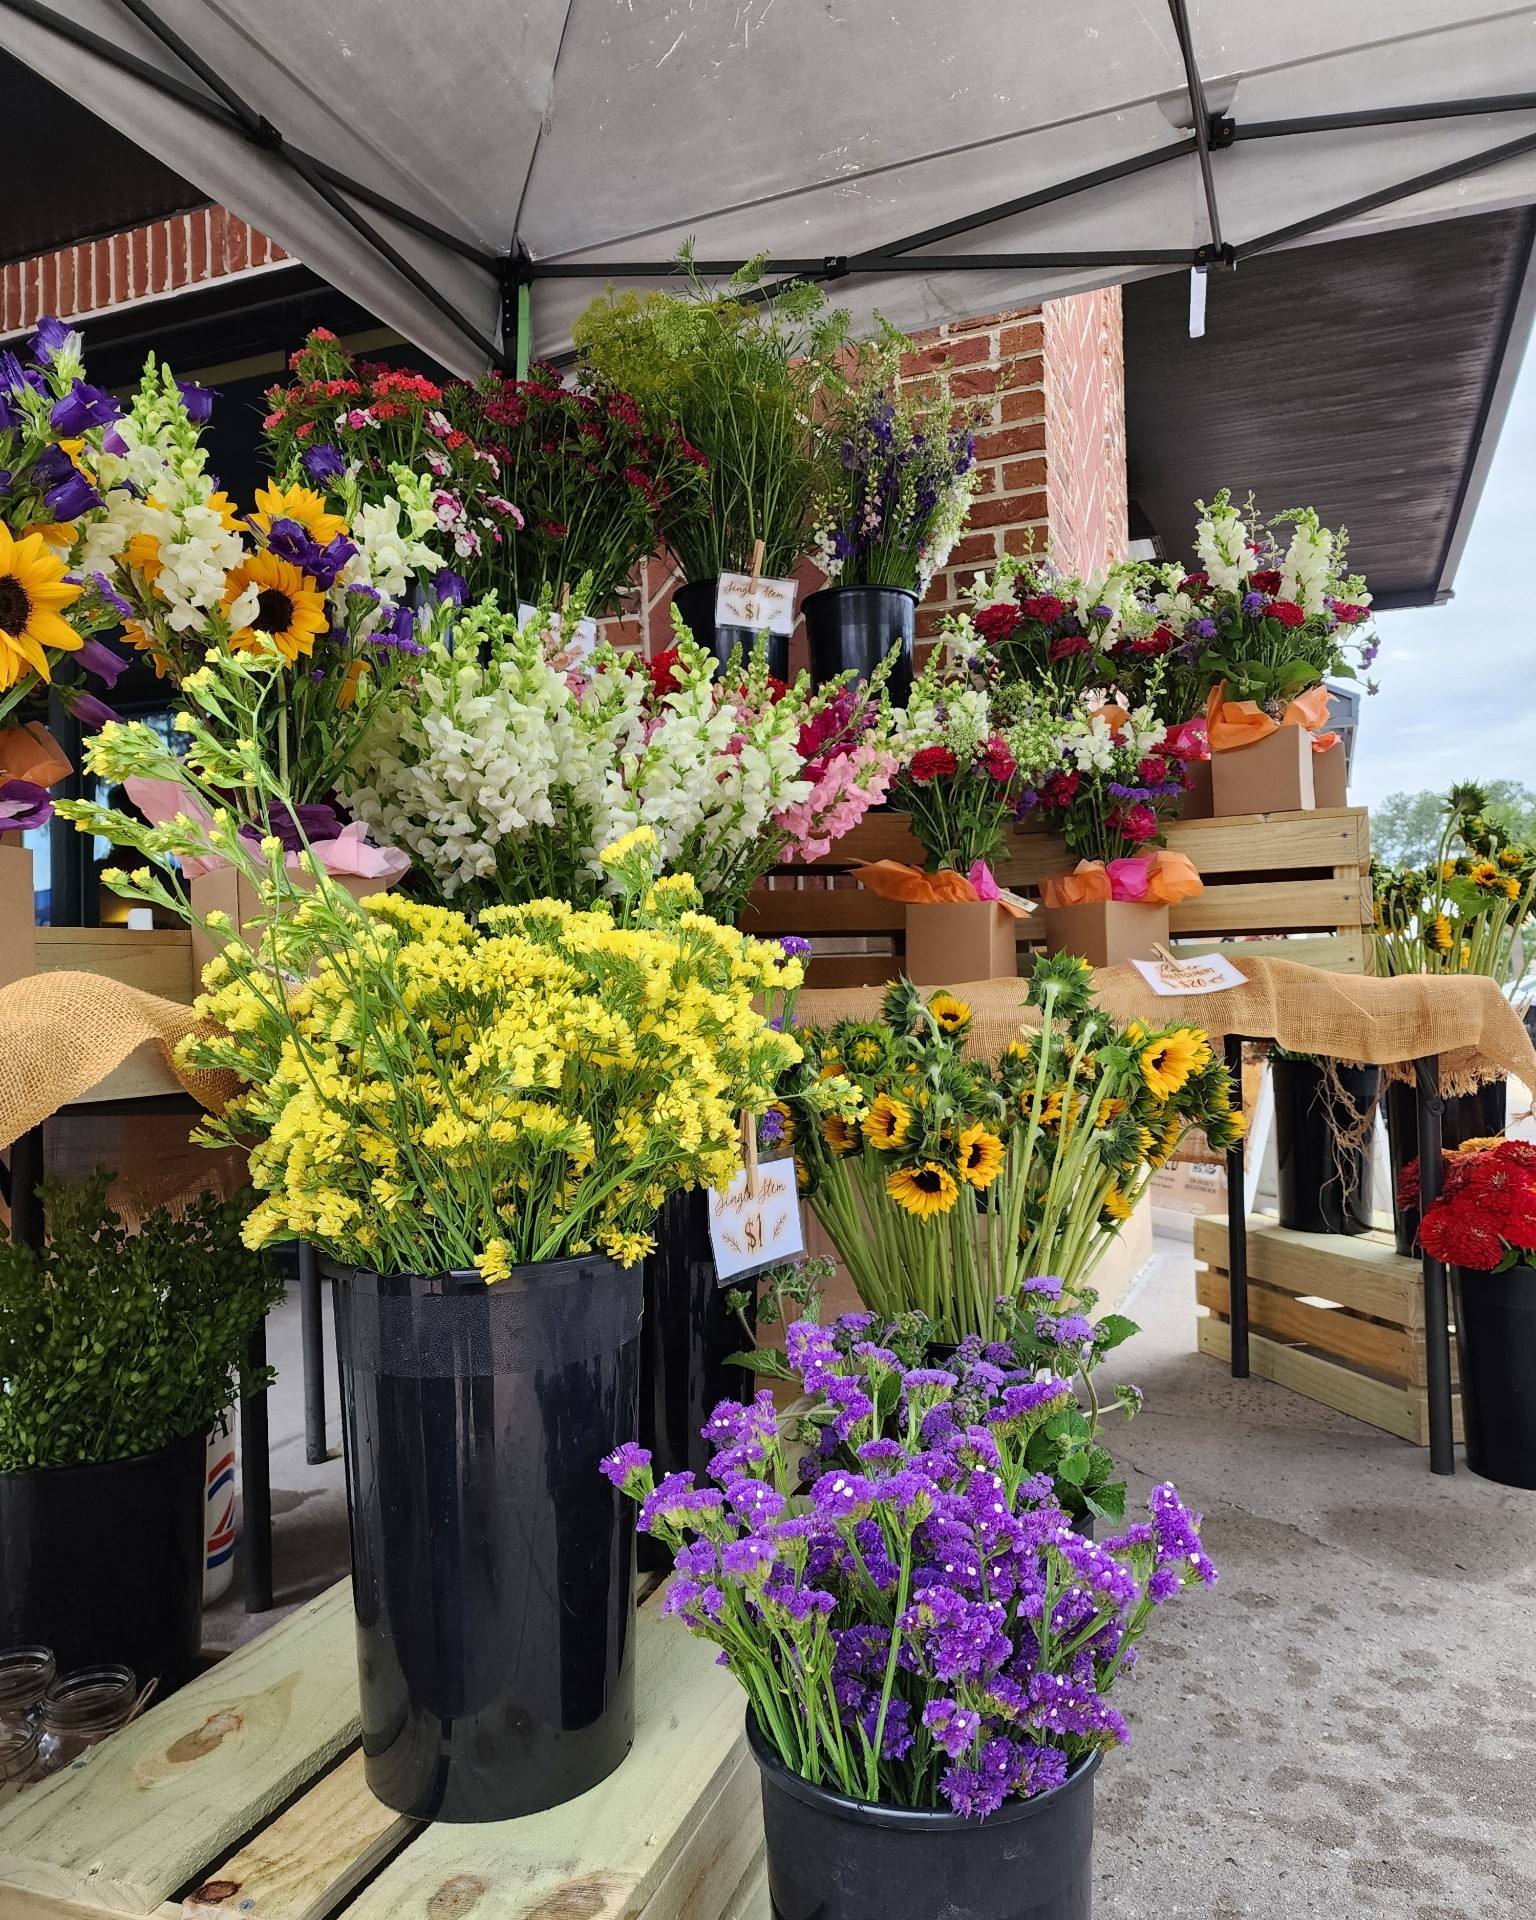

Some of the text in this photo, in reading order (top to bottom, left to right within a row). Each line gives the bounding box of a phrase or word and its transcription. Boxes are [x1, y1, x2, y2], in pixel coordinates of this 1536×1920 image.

[760, 586, 785, 599] Stem
[745, 600, 760, 621] $1
[1160, 967, 1216, 979] ARRANGEMENT
[1179, 978, 1207, 988] $20
[757, 1178, 787, 1204] Stem
[744, 1212, 763, 1255] $1
